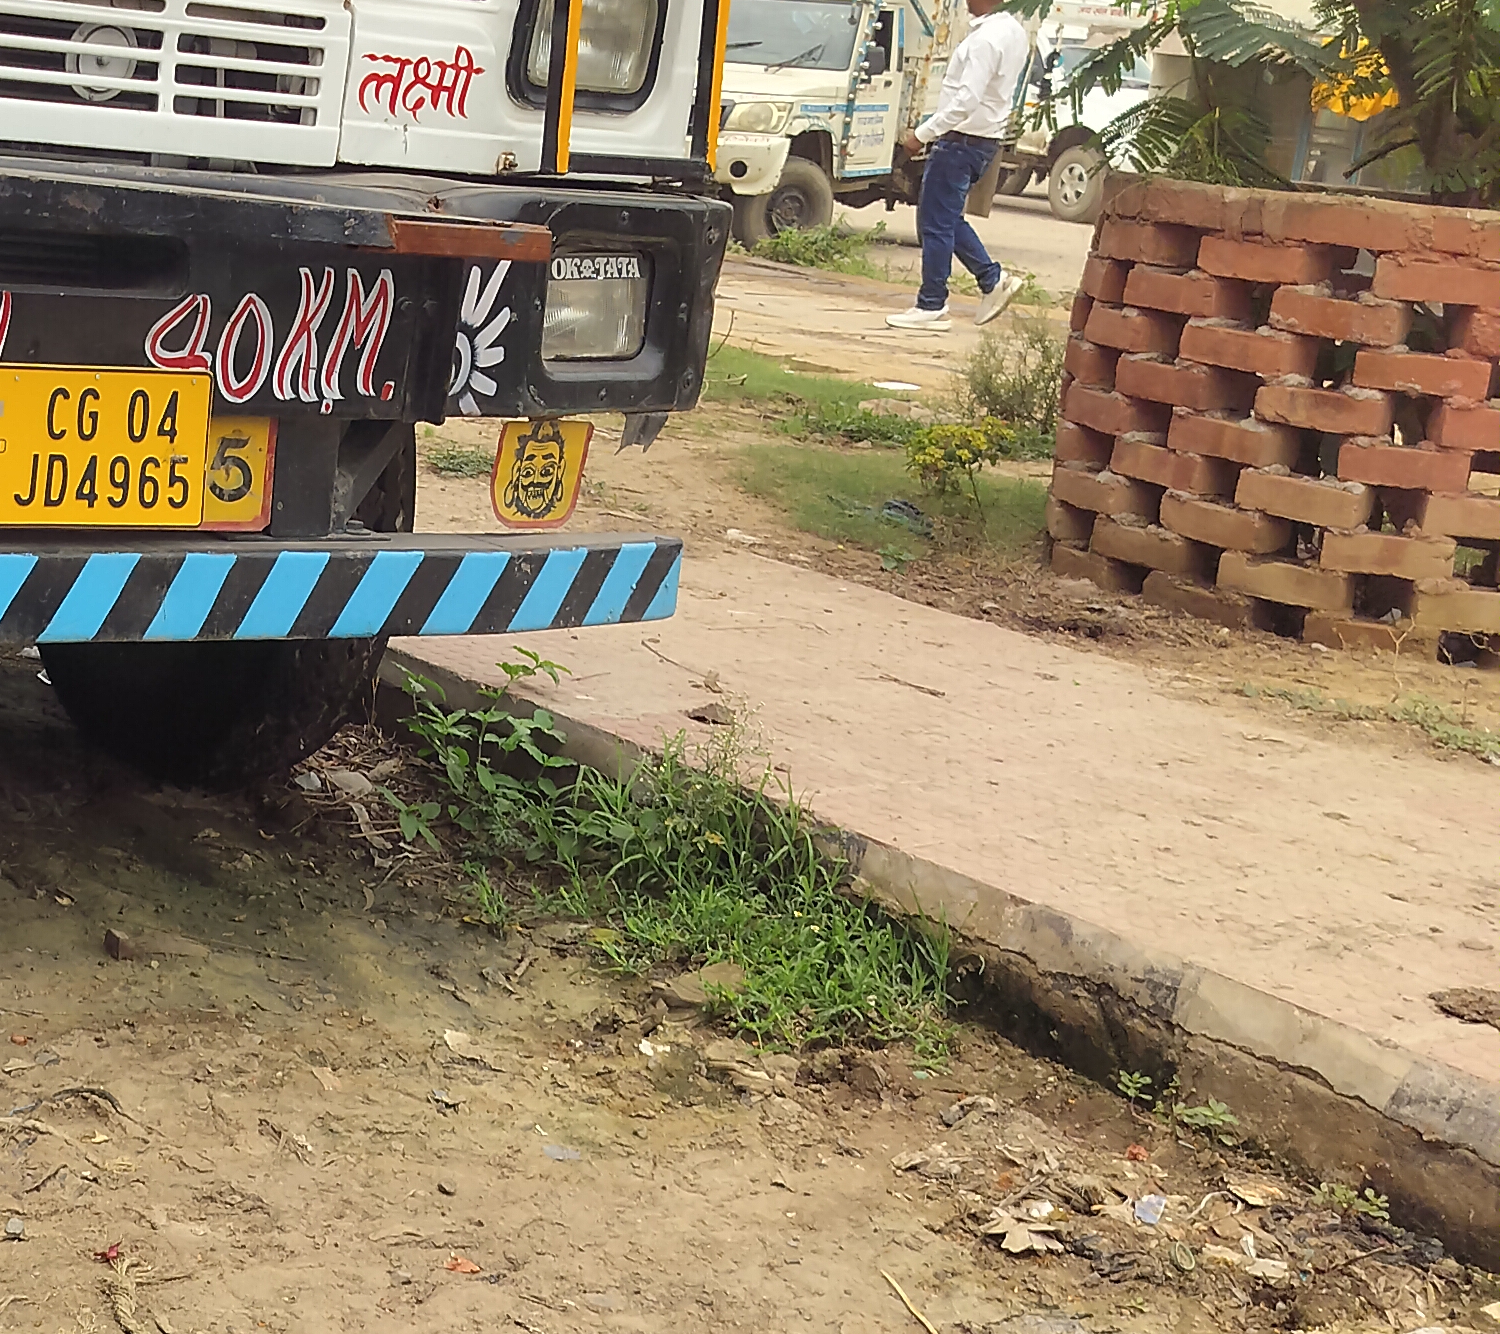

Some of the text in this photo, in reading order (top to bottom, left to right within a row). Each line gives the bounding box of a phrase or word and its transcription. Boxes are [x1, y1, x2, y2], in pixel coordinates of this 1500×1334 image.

[357, 44, 486, 124] लक्ष्मी
[551, 257, 641, 280] OK TATA
[46, 387, 180, 444] CG 04
[13, 453, 190, 510] JD4965
